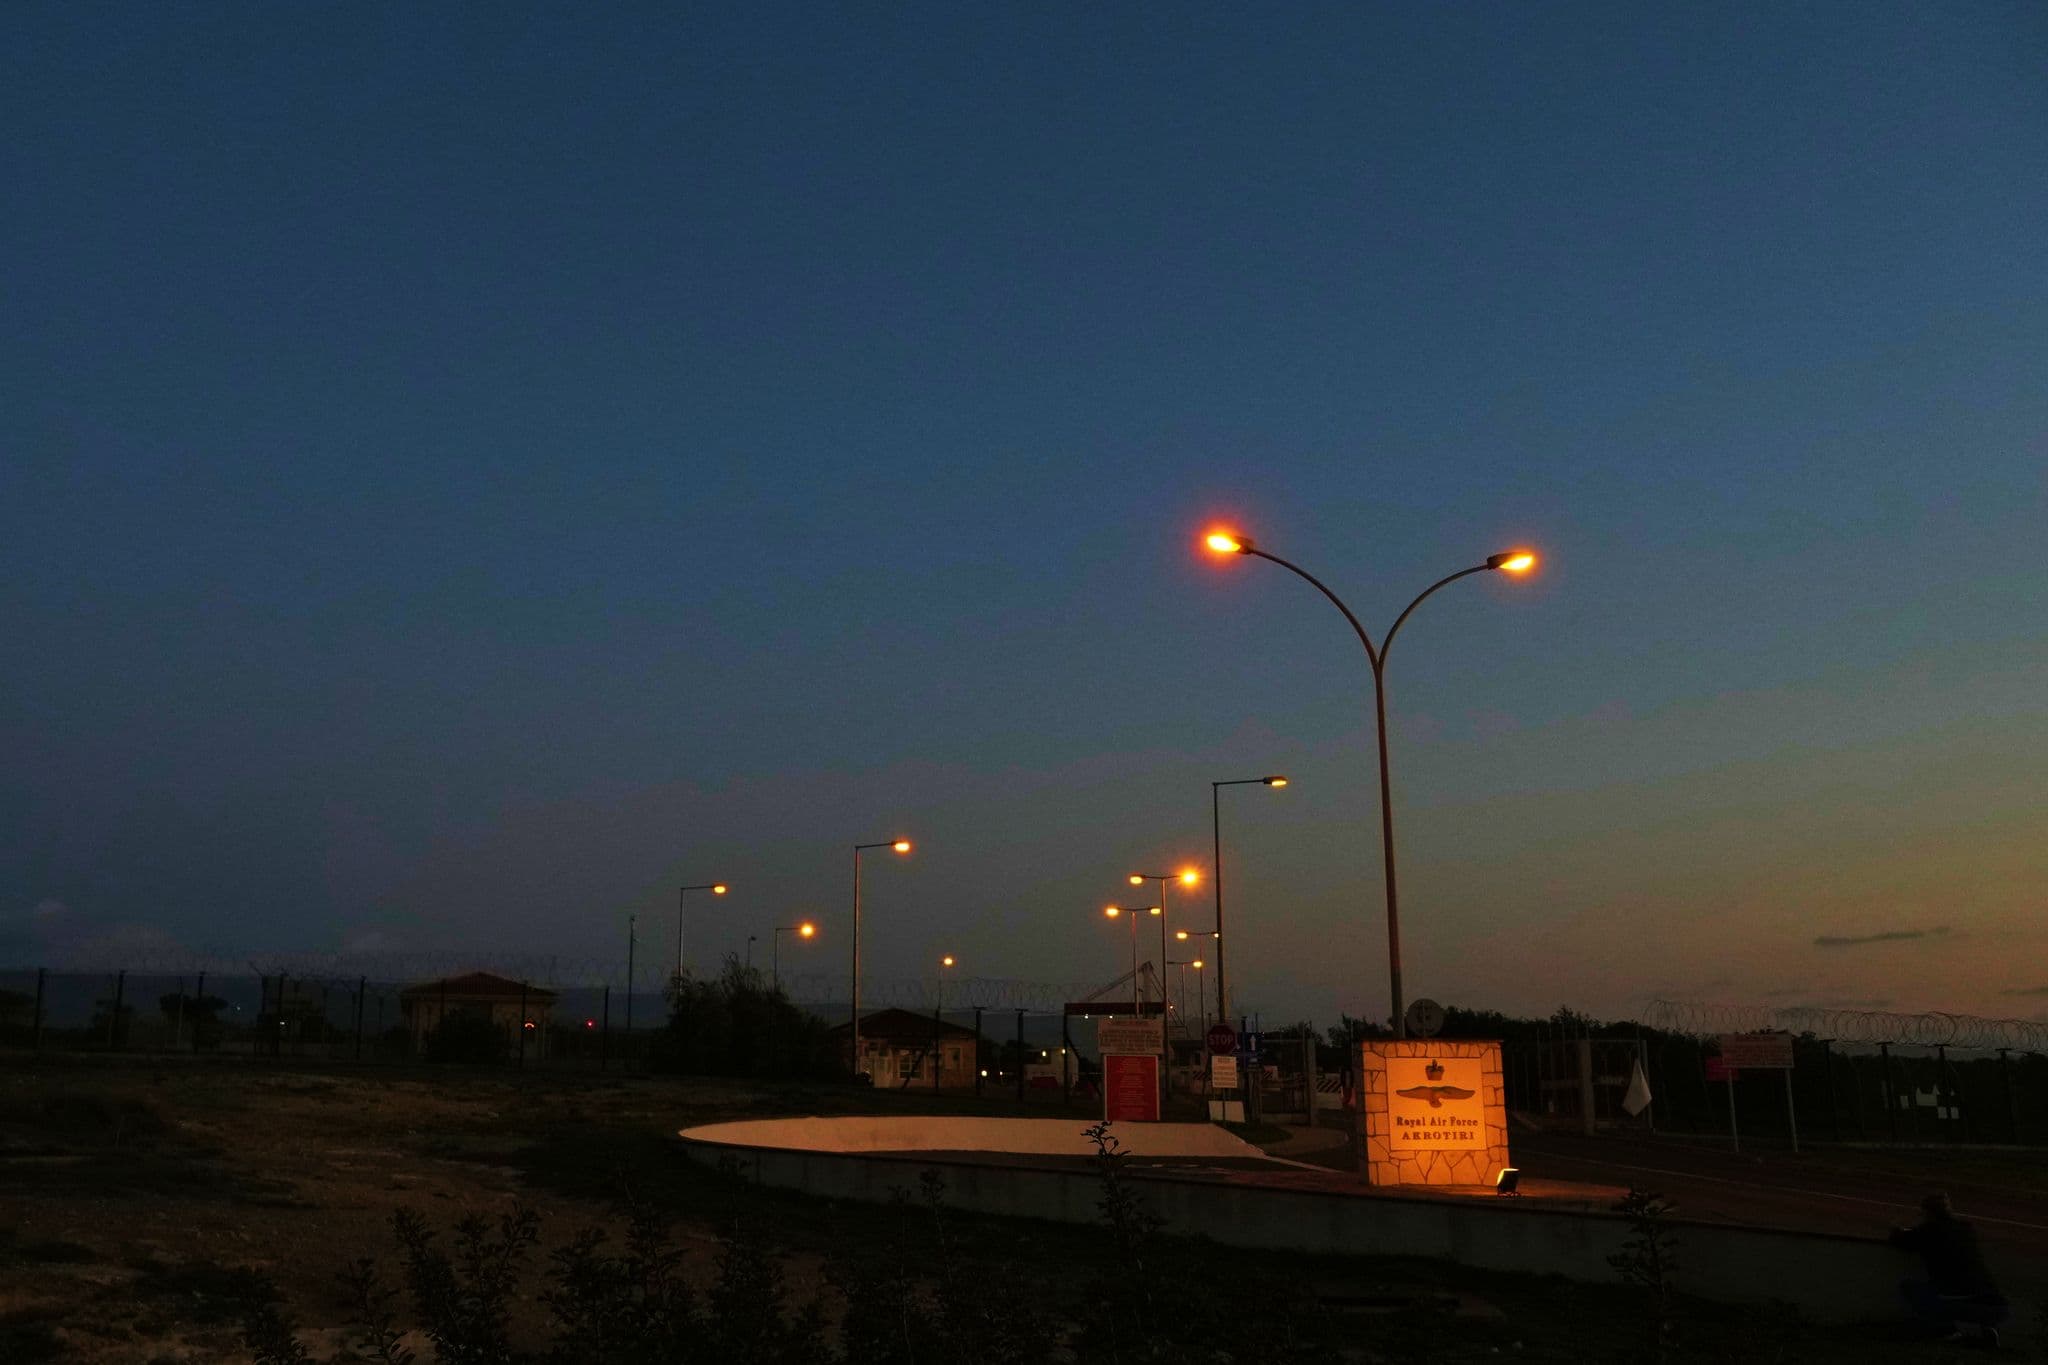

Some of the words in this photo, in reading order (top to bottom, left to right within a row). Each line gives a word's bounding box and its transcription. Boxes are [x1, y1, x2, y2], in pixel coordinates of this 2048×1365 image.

[1209, 1035, 1233, 1046] STOP
[1396, 1116, 1426, 1128] Royal
[1430, 1116, 1447, 1126] Air
[1450, 1116, 1478, 1126] Force
[1402, 1131, 1475, 1140] AKROTIRI
